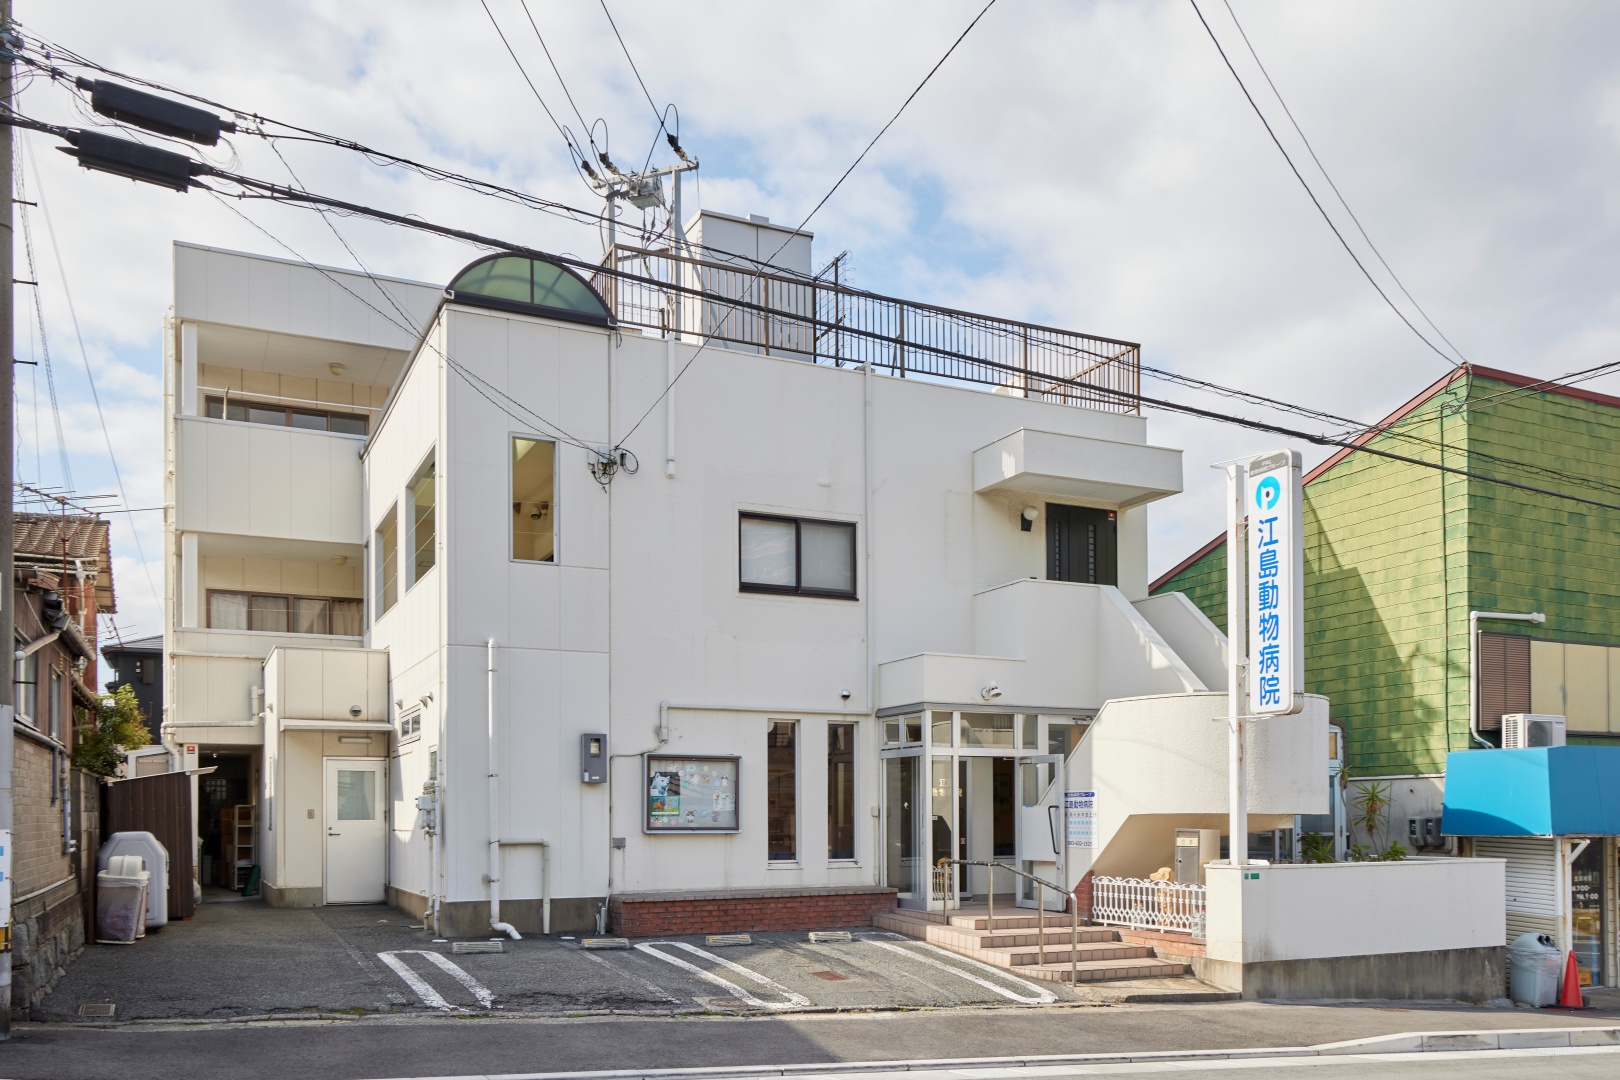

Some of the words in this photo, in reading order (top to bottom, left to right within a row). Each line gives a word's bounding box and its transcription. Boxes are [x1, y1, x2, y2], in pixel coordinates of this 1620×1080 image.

[1257, 516, 1281, 707] 江島動物病院
[932, 787, 963, 797] 動物院
